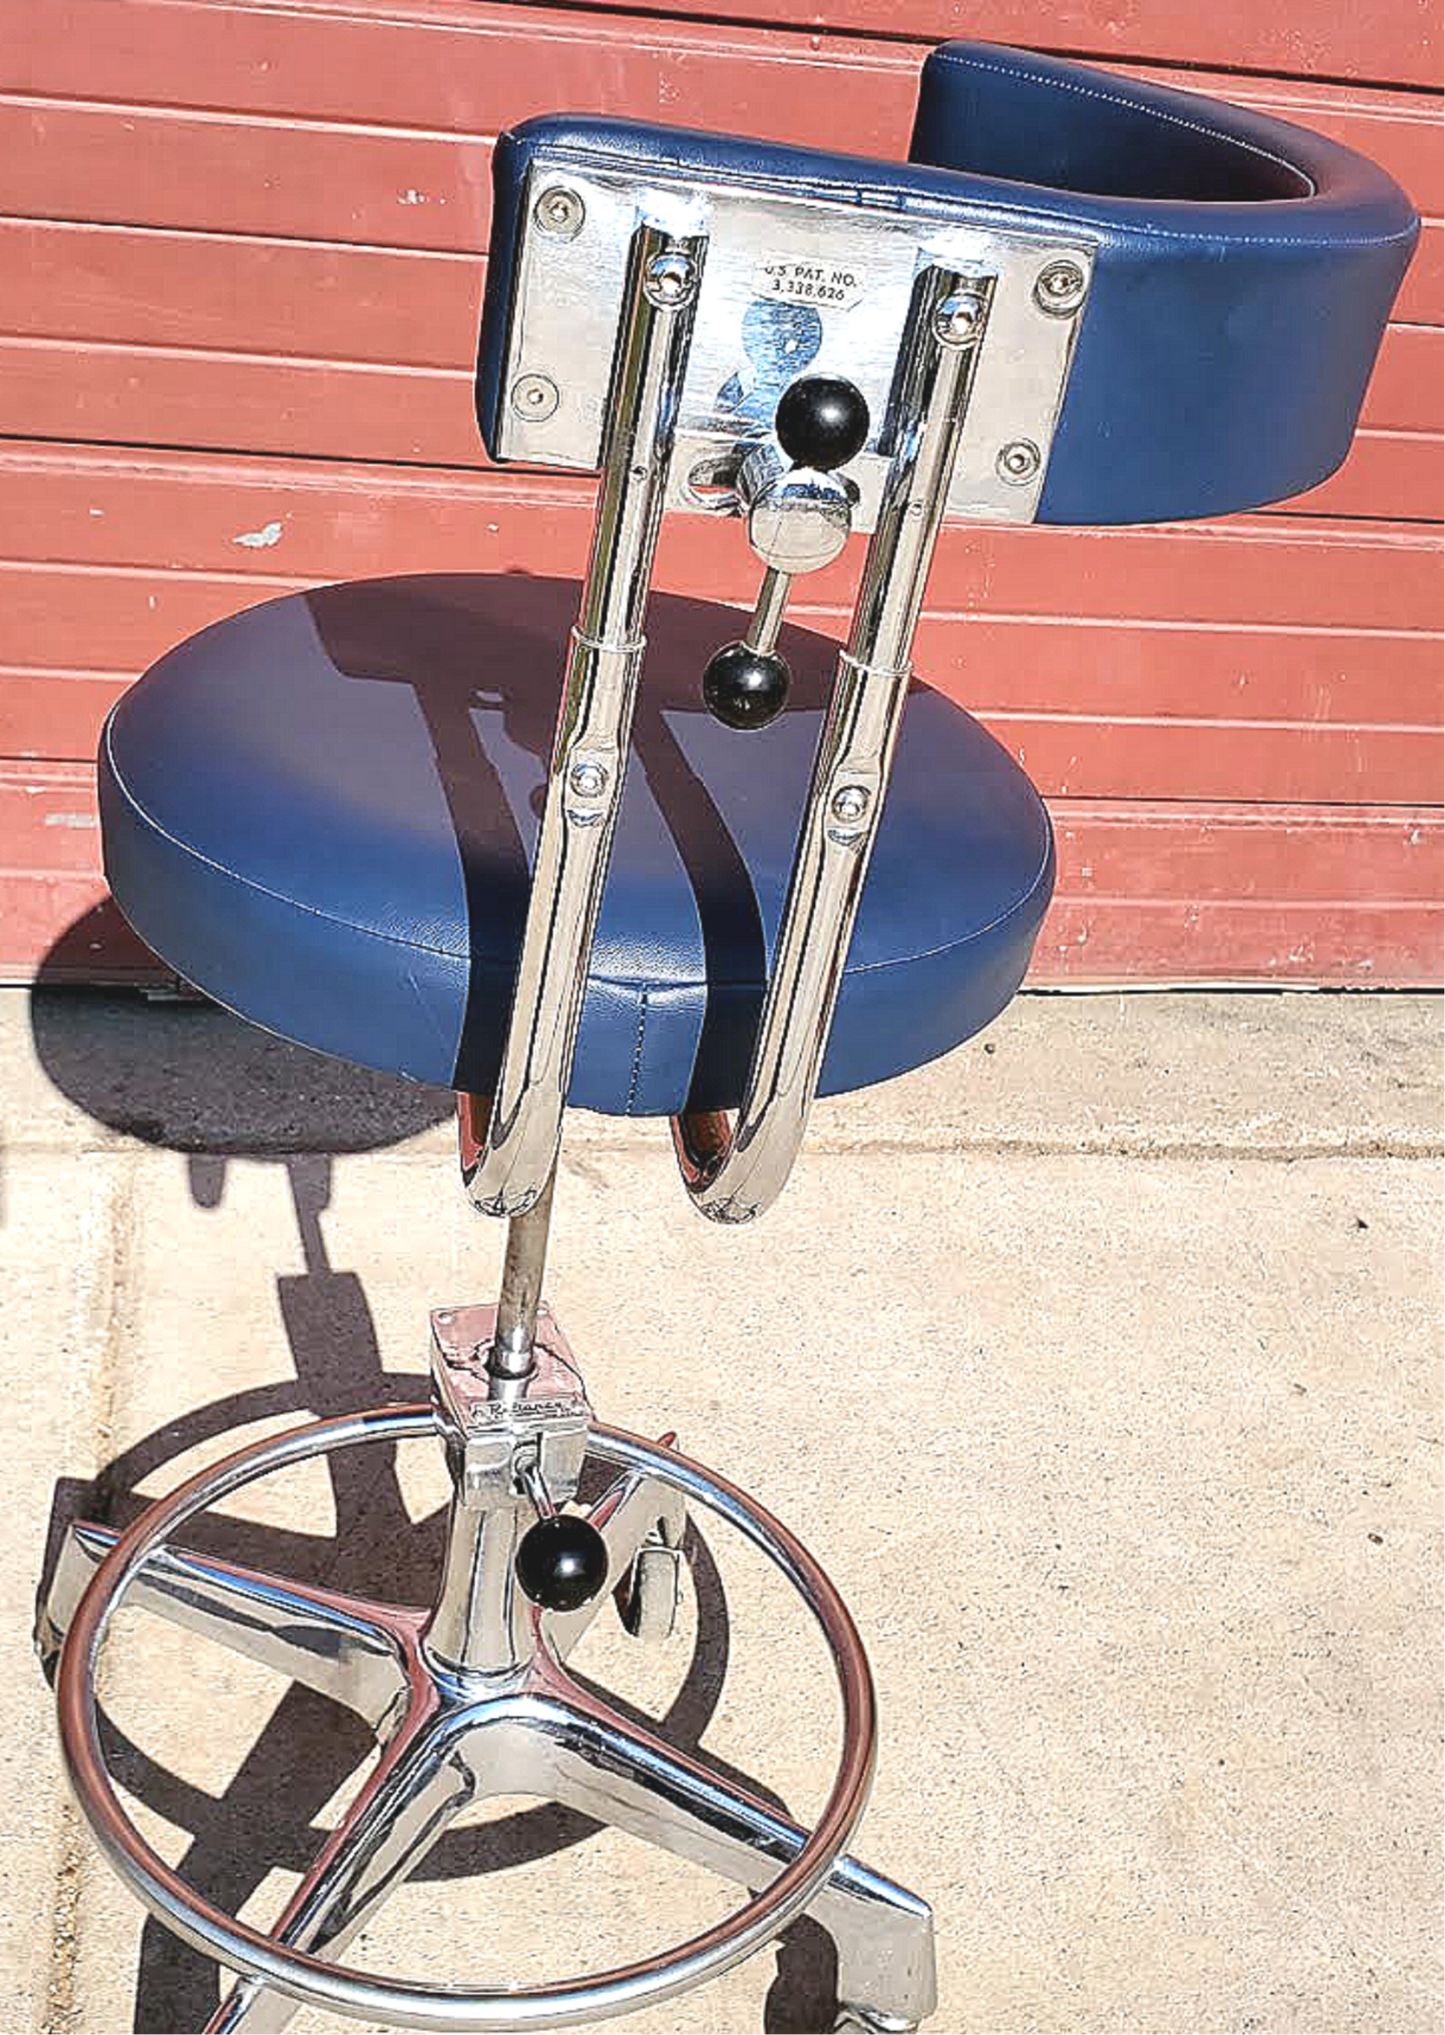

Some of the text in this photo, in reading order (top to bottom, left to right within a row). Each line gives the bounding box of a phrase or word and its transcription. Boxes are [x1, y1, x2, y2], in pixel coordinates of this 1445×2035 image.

[794, 266, 826, 283] PAT.
[830, 271, 857, 288] NO.
[771, 278, 845, 301] 3,338,626
